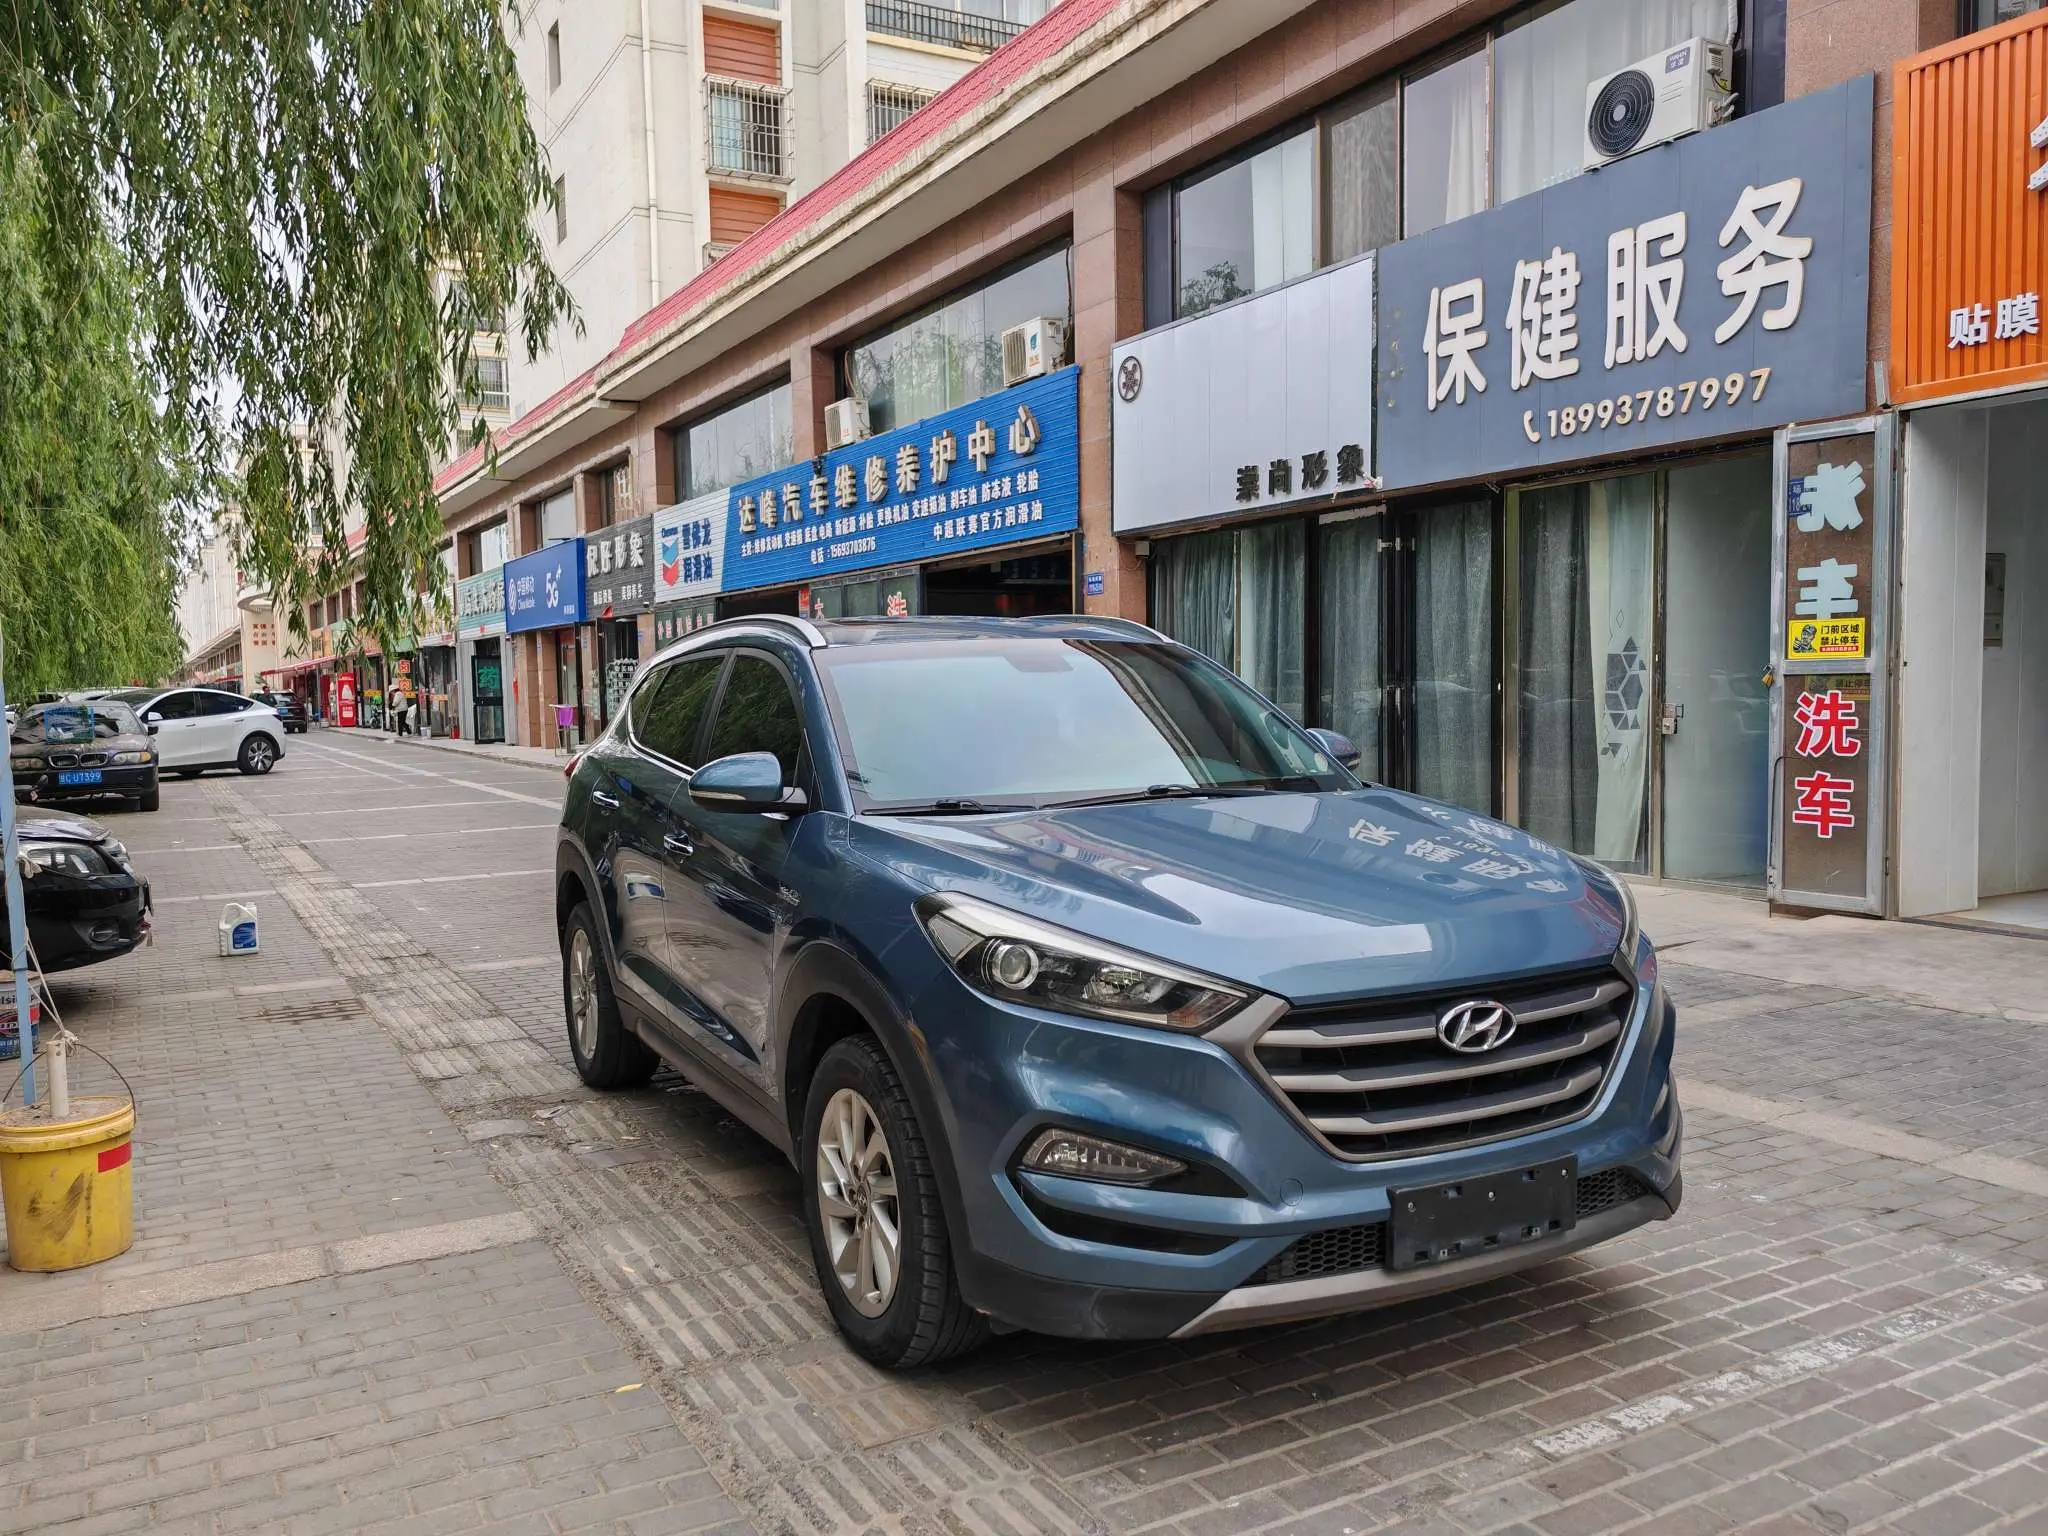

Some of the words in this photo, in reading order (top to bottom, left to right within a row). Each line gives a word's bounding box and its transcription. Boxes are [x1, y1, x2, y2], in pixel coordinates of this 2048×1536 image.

[1422, 177, 1813, 412] 保健服务
[1948, 292, 2040, 349] 贴膜
[1547, 367, 1772, 438] 18993787997
[739, 404, 1040, 534] 达峰汽车维修养护中心
[981, 476, 1012, 502] 防冻液
[1016, 468, 1039, 494] 轮胎
[933, 499, 1043, 541] 中超联赛官方润滑油
[683, 551, 713, 584] 润滑油
[1820, 636, 1860, 646] 禁止停车
[1821, 624, 1860, 635] 门前区域
[1793, 690, 1862, 838] 洗车
